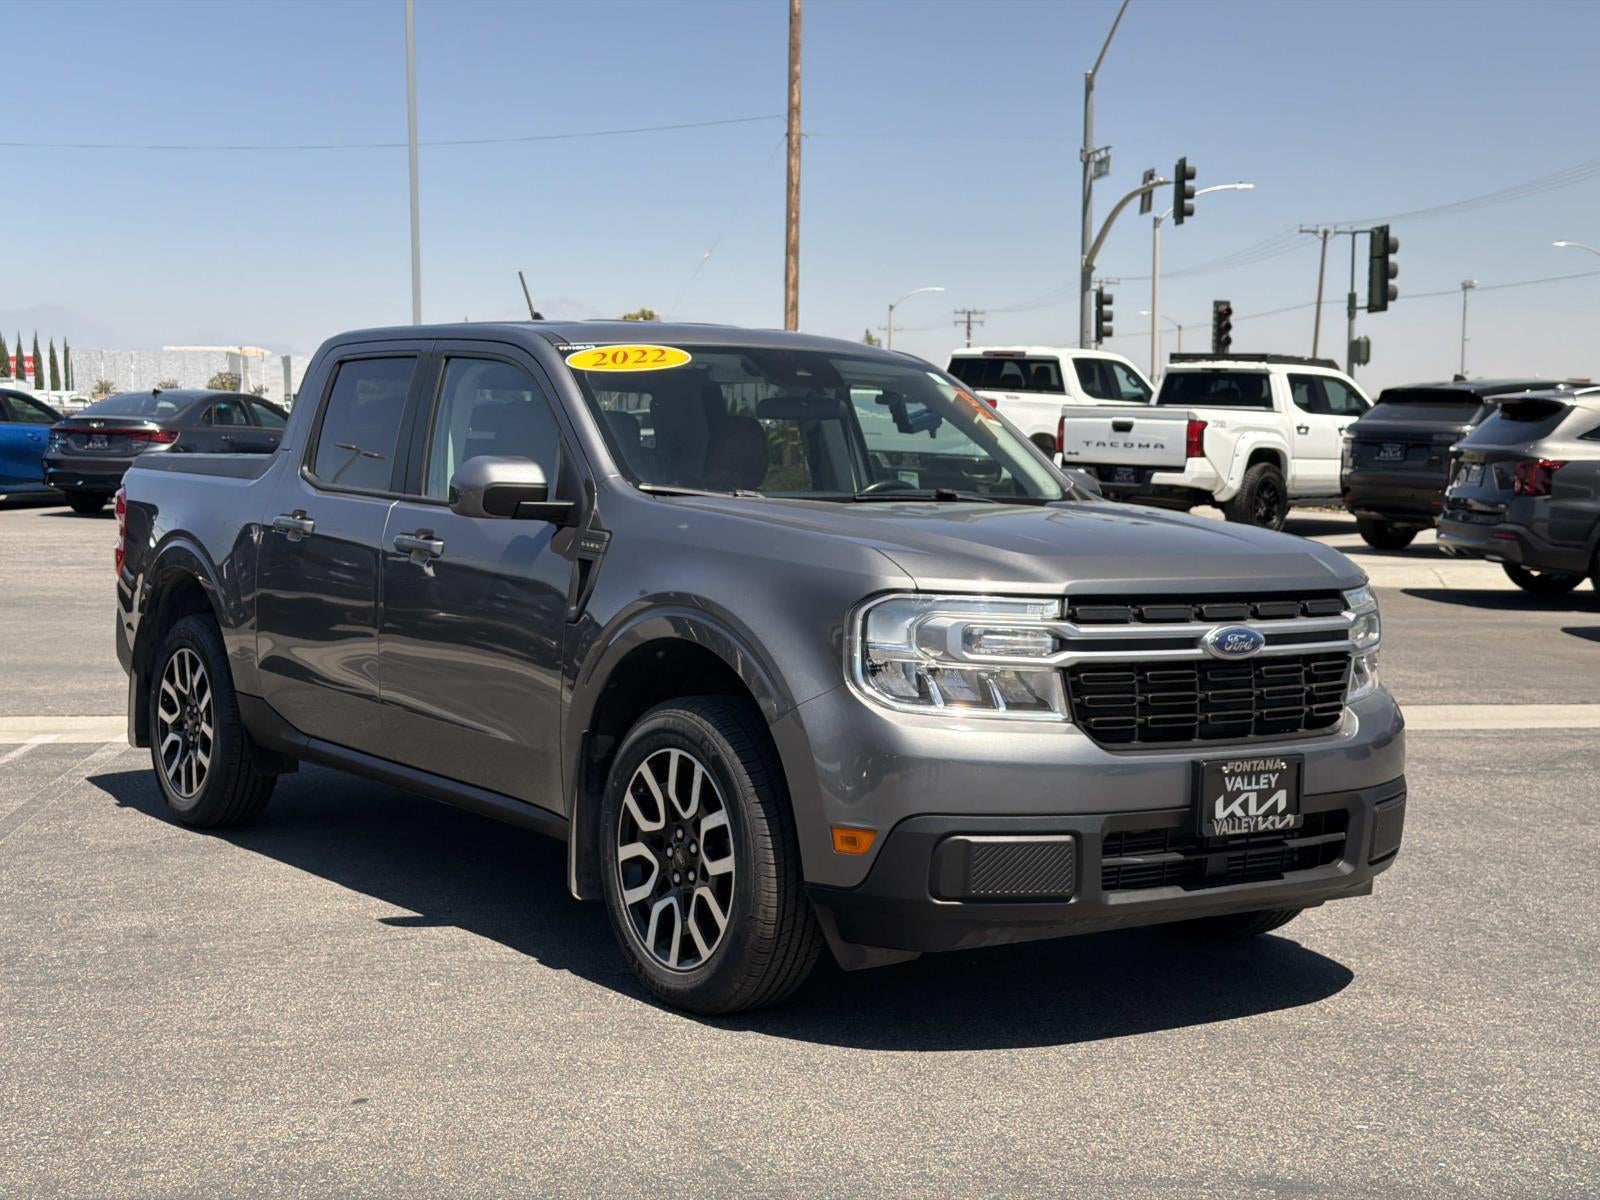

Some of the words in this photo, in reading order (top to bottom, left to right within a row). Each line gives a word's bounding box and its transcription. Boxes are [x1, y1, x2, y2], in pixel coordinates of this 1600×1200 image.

[592, 349, 666, 367] 2022
[1082, 440, 1166, 449] TACOMA
[1224, 633, 1254, 652] Ford
[1227, 759, 1281, 772] FONTANA
[1224, 772, 1280, 792] VALLEY
[1214, 789, 1288, 819] KIA
[1212, 816, 1257, 836] VALLEY
[1257, 813, 1295, 831] KIA
